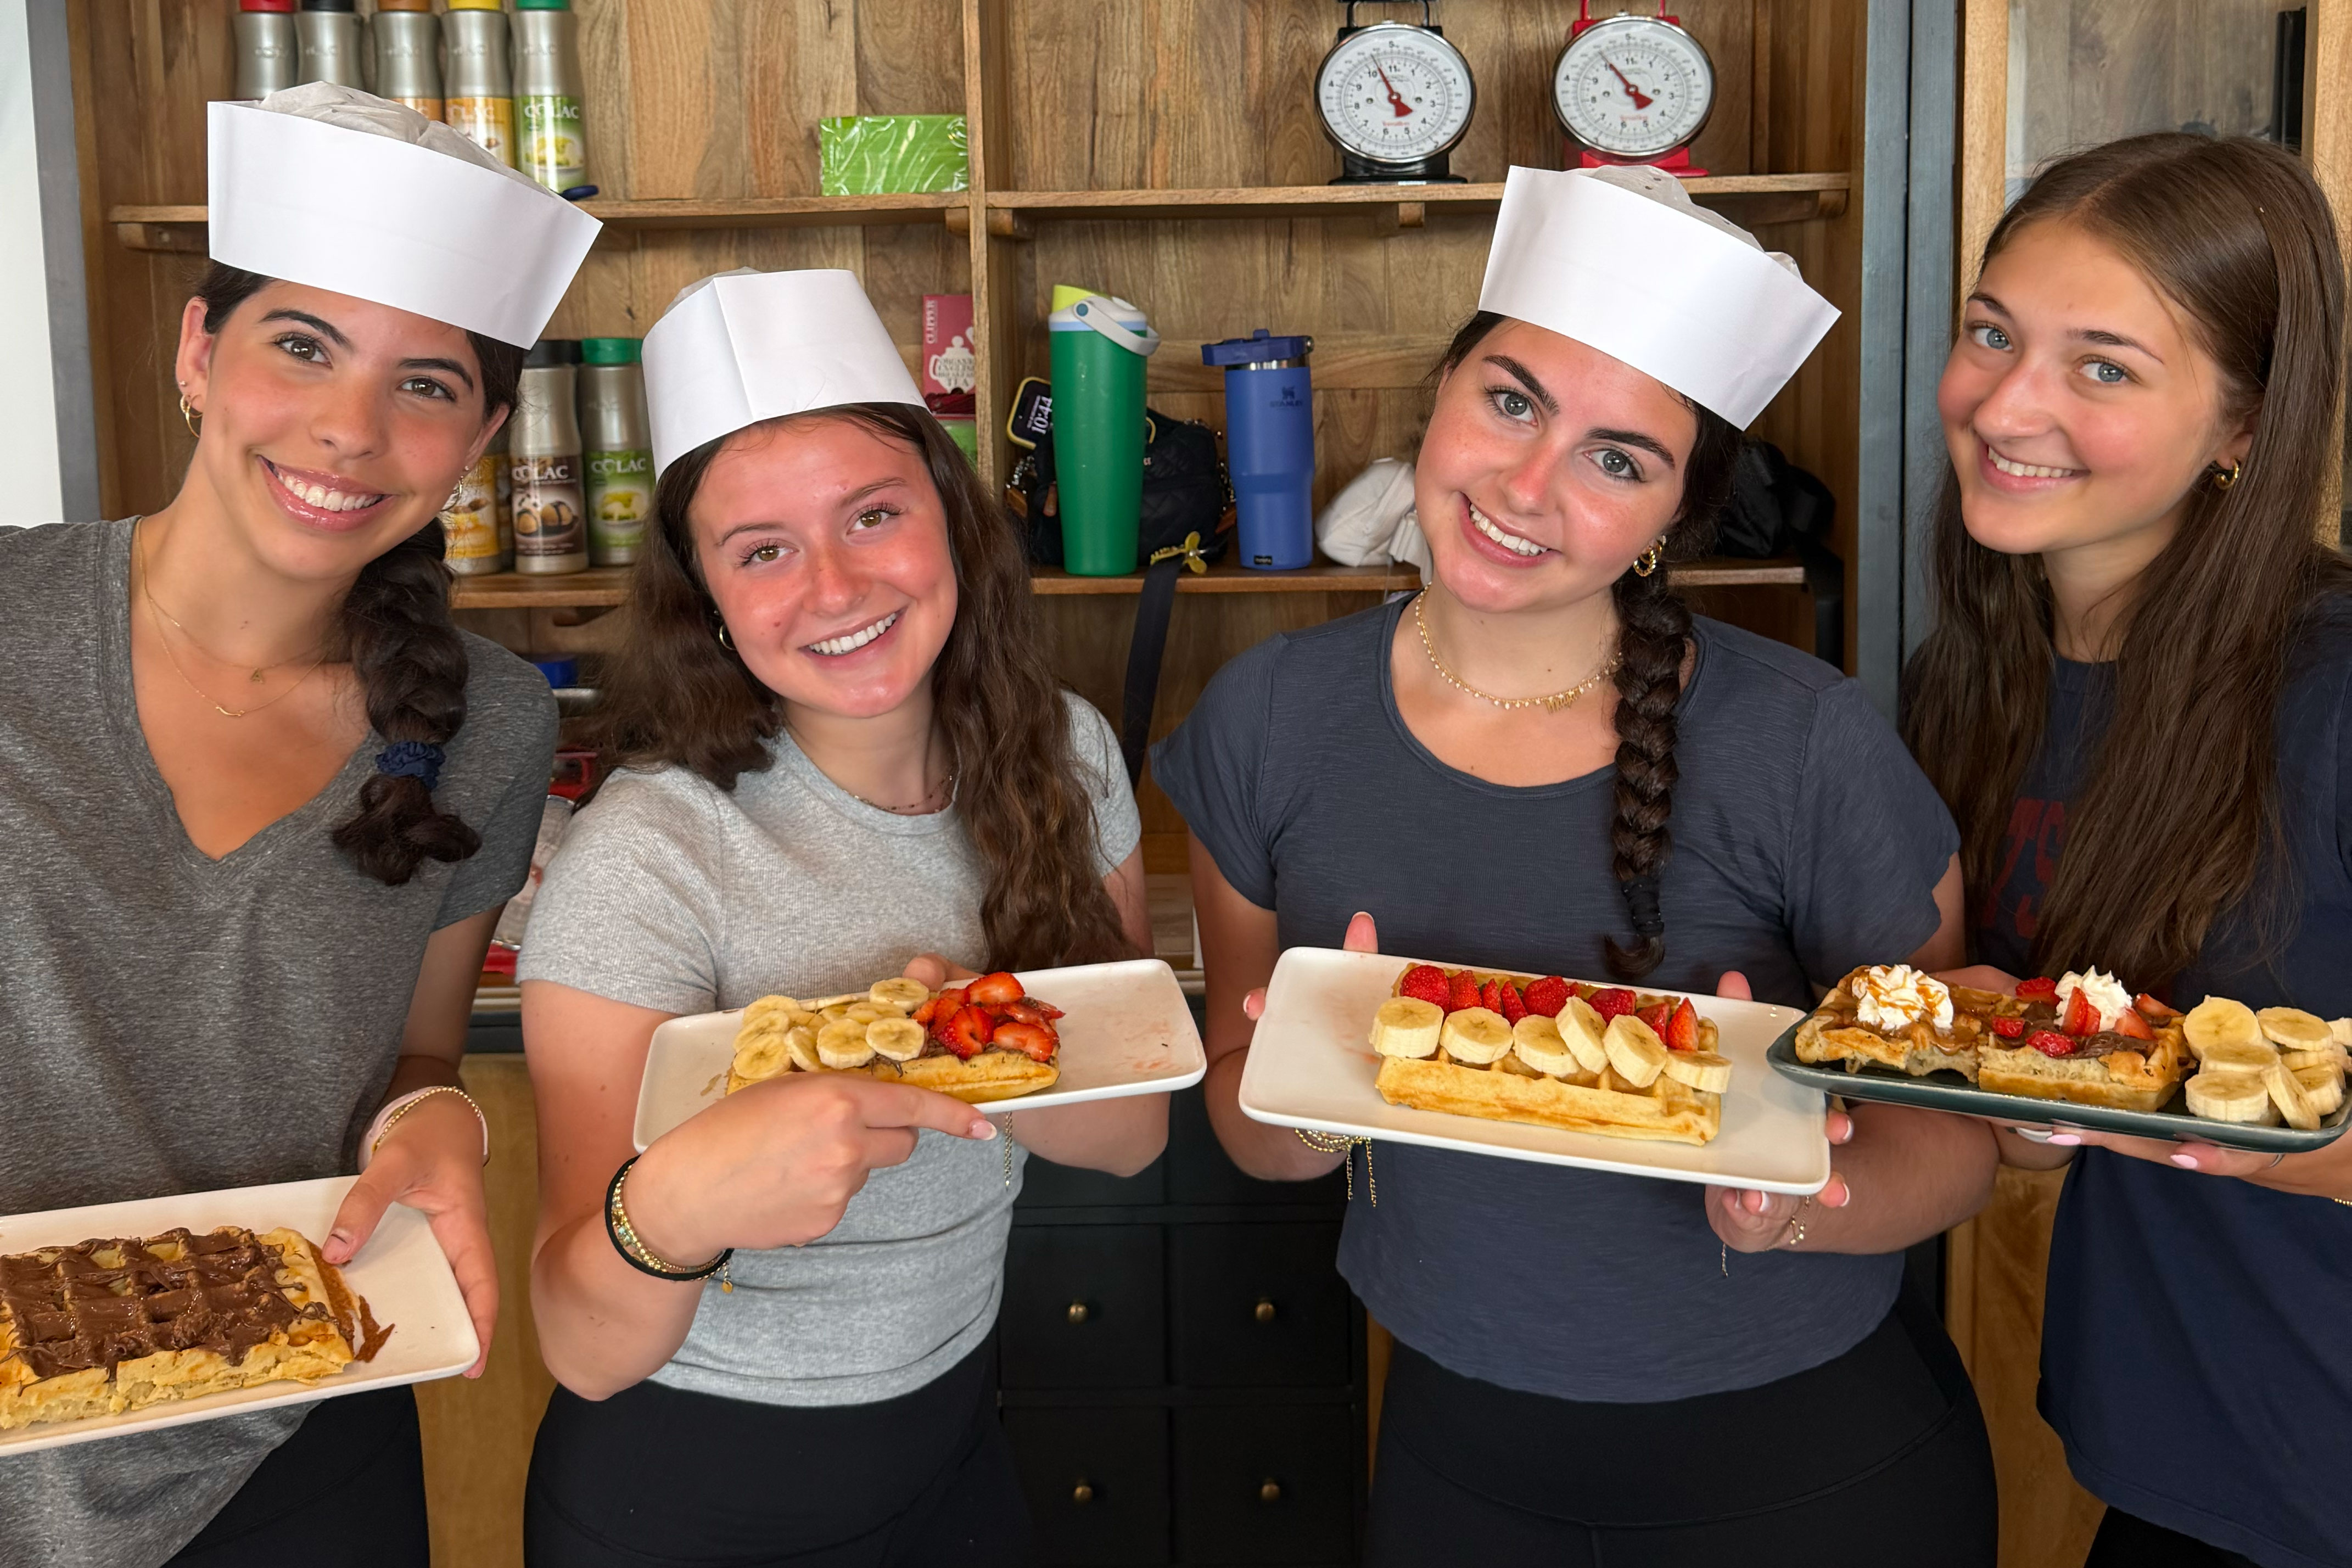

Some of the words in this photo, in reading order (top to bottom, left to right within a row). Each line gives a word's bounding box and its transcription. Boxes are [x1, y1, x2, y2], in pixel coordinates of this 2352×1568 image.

[1430, 99, 1436, 108] 3
[947, 378, 969, 387] TEA
[1031, 395, 1052, 434] 10:44
[511, 464, 569, 482] COLAC
[591, 457, 646, 475] COLAC
